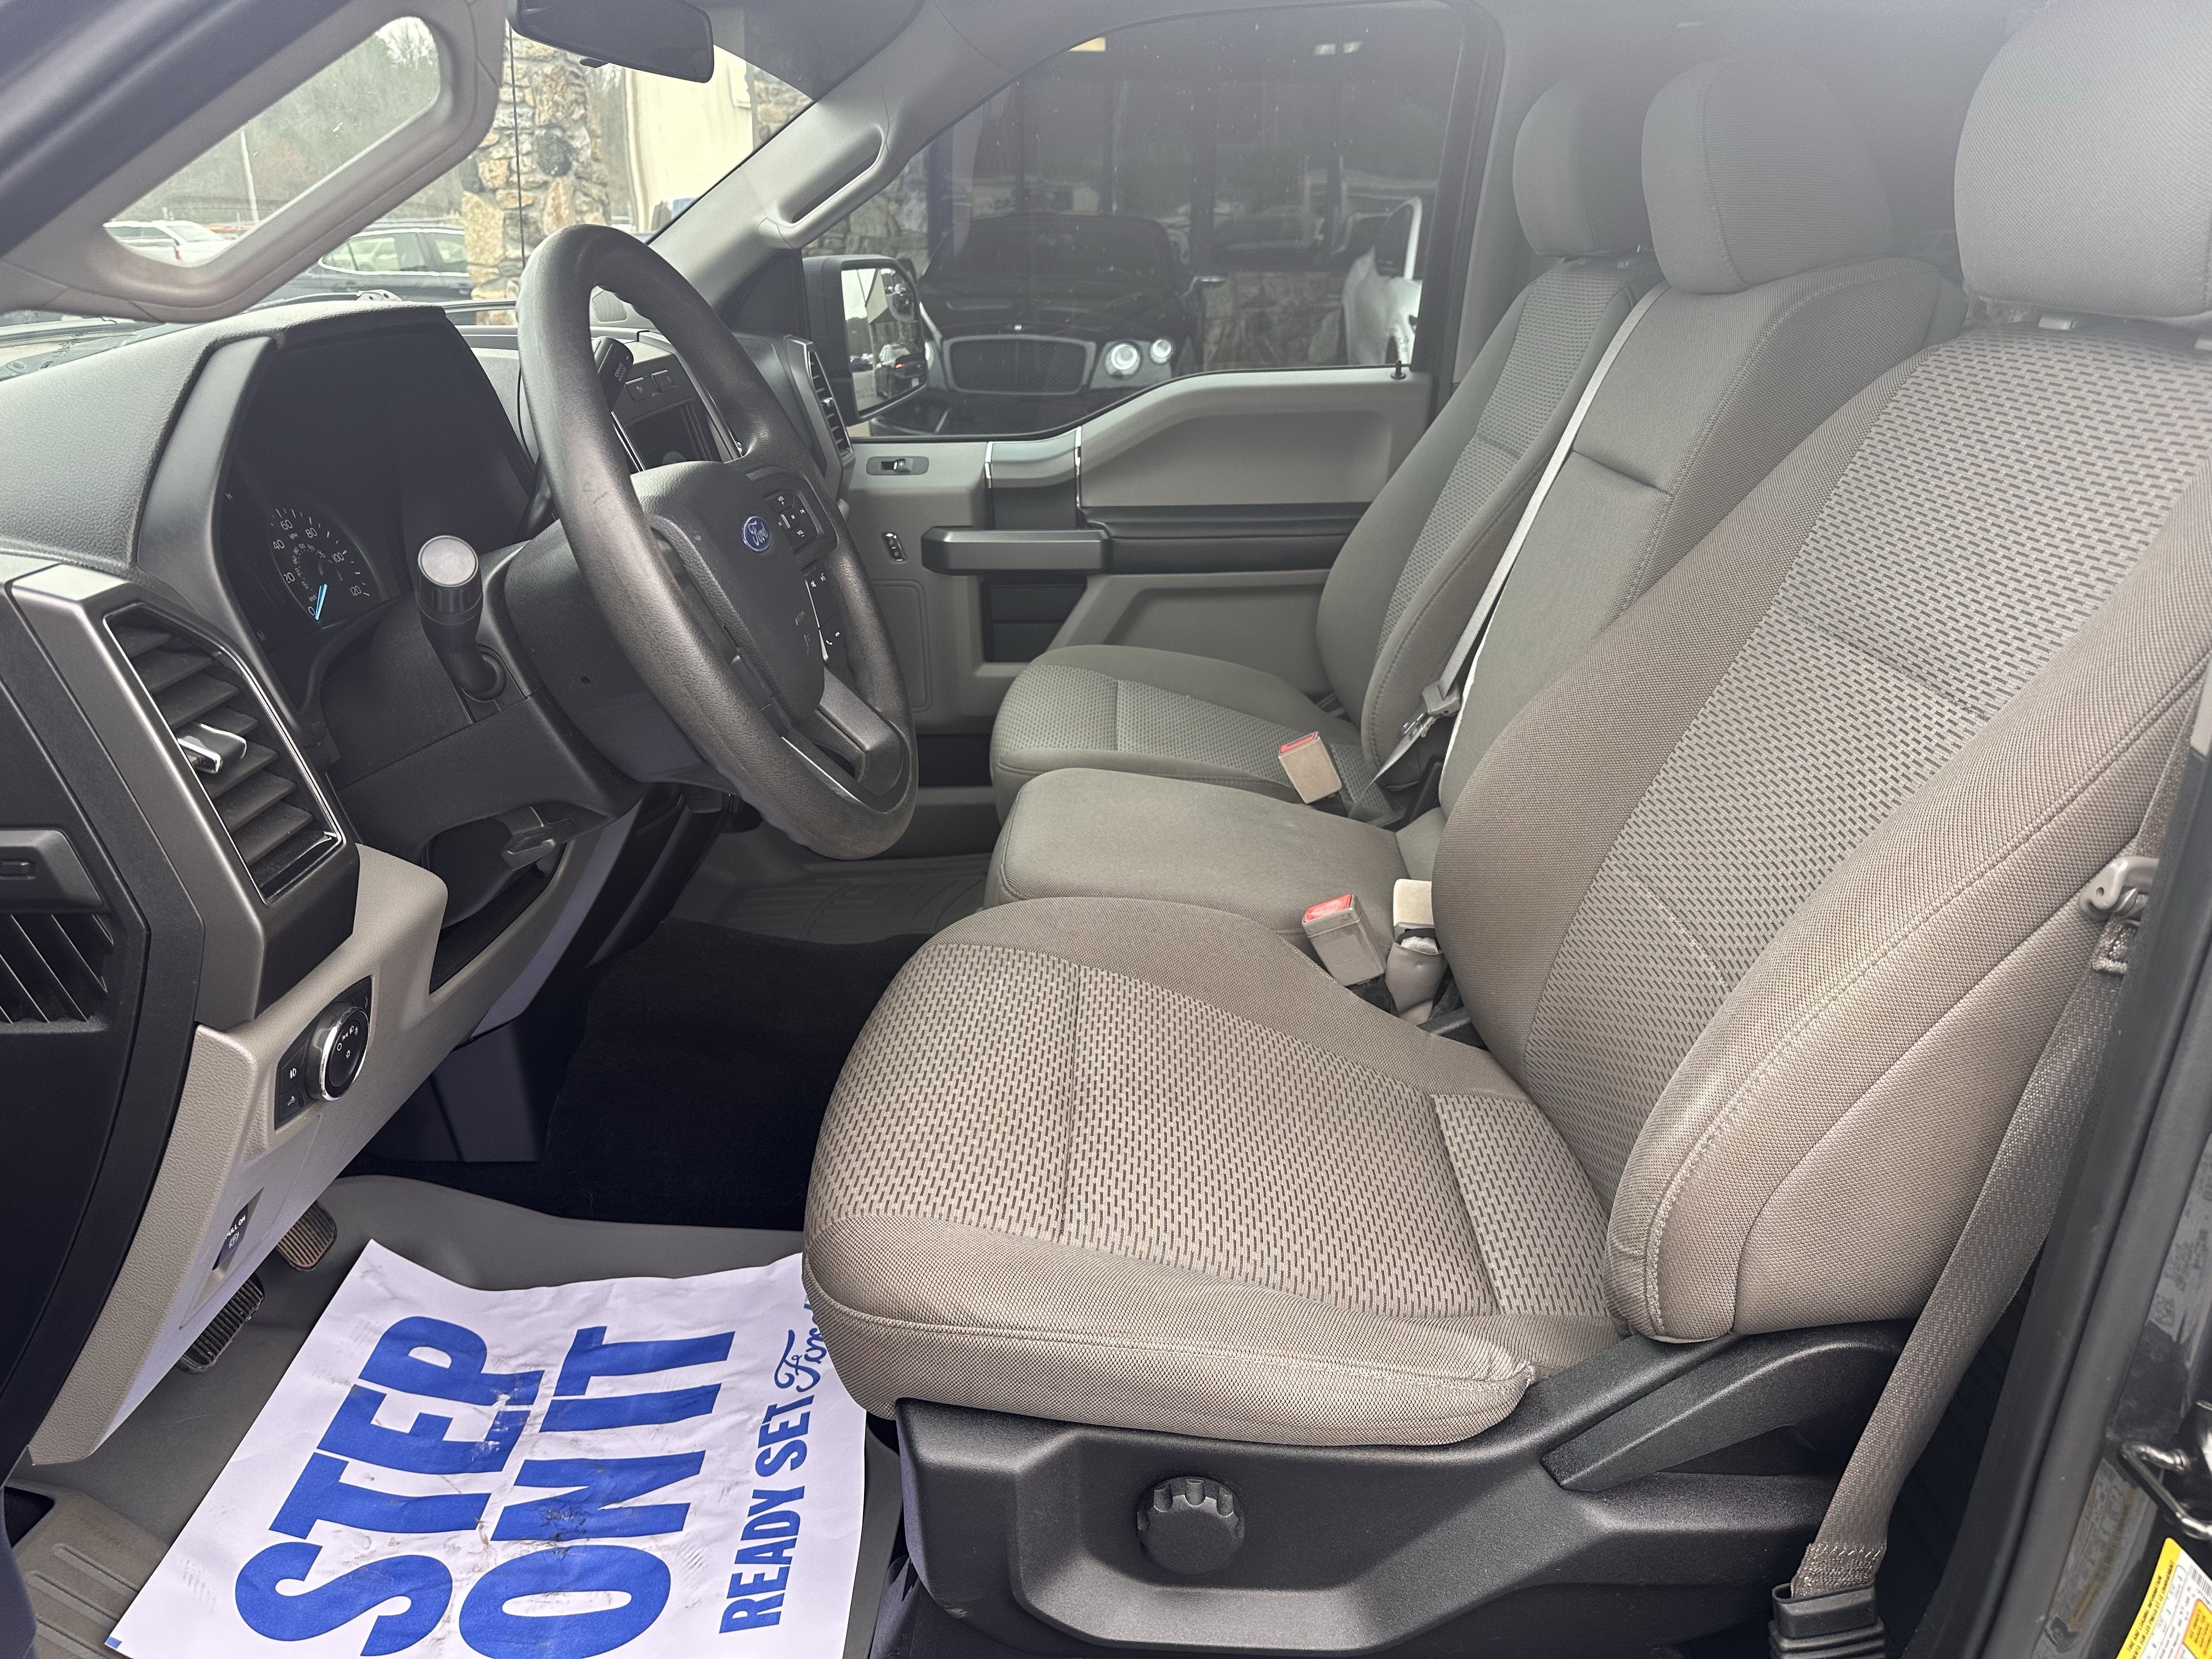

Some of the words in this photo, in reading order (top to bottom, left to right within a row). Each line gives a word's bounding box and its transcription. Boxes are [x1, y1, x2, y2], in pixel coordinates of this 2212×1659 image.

[614, 362, 625, 378] DRIVE
[280, 520, 293, 531] 60
[305, 527, 318, 538] 80
[748, 520, 769, 546] Ford
[273, 539, 285, 550] 40
[331, 552, 345, 563] 100
[283, 572, 295, 584] 20
[349, 585, 362, 596] 120
[308, 606, 315, 616] 0
[238, 1215, 246, 1226] ON
[774, 1303, 827, 1392] For
[538, 1325, 736, 1432] IT
[754, 1394, 815, 1478] SET
[234, 1316, 545, 1657] STEP
[459, 1449, 707, 1659] ON
[719, 1485, 805, 1634] READY
[2127, 1640, 2135, 1652] TIRE
